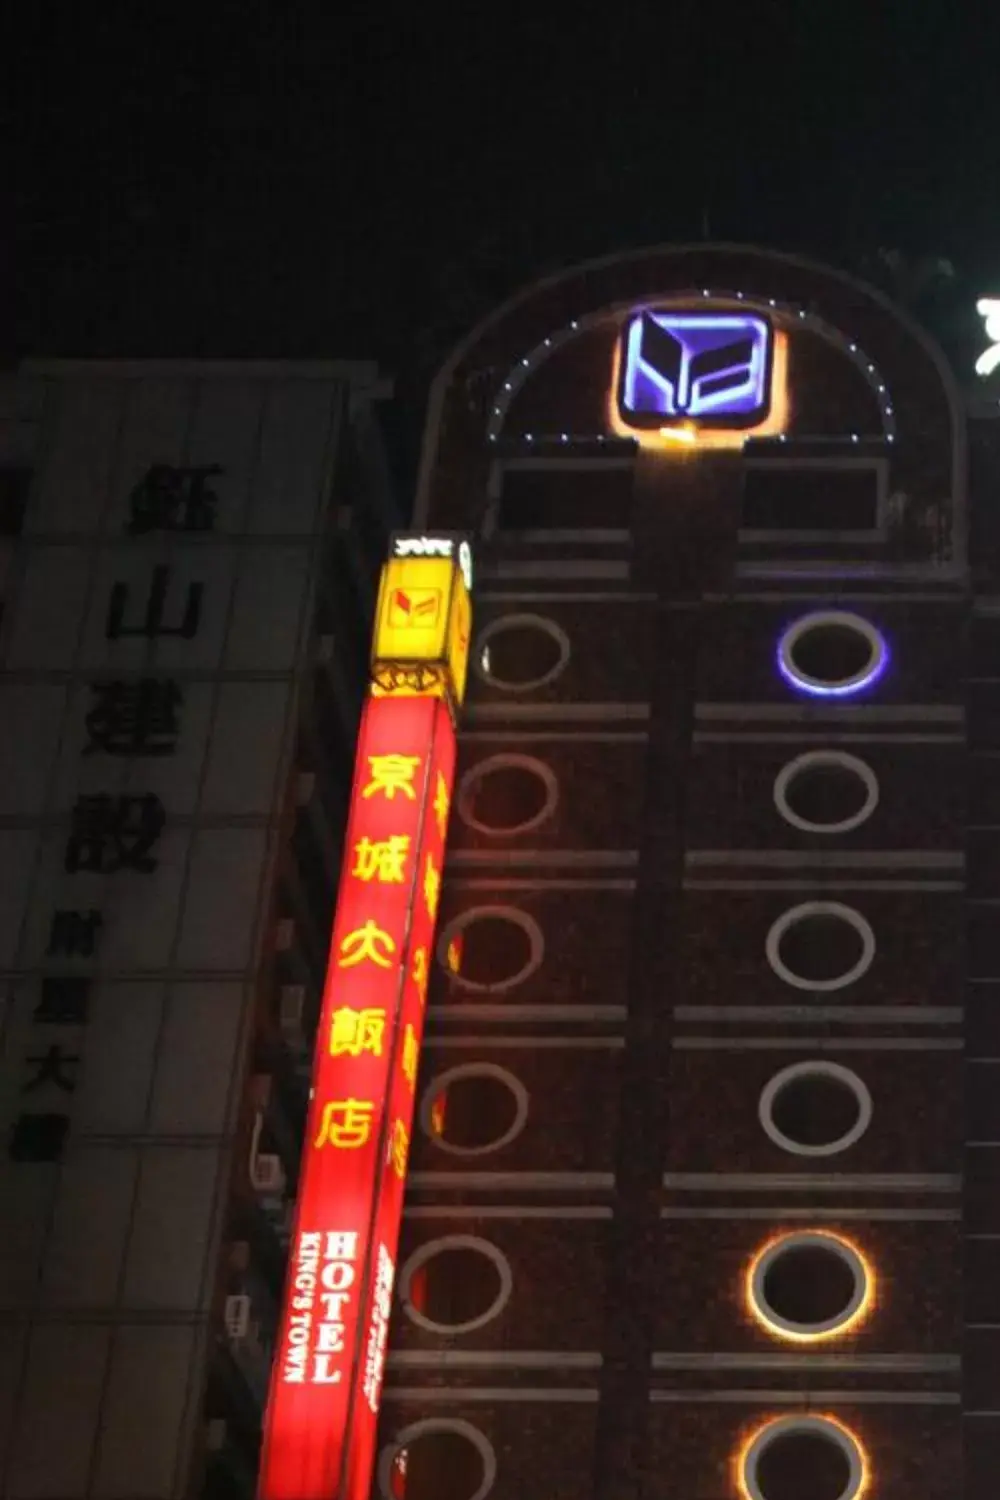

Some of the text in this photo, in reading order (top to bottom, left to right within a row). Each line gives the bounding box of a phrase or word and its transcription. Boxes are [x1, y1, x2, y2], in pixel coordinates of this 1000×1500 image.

[315, 754, 422, 1149] 京城大飯店
[284, 1231, 321, 1383] KING'S TOWN
[312, 1231, 357, 1384] HOTEL
